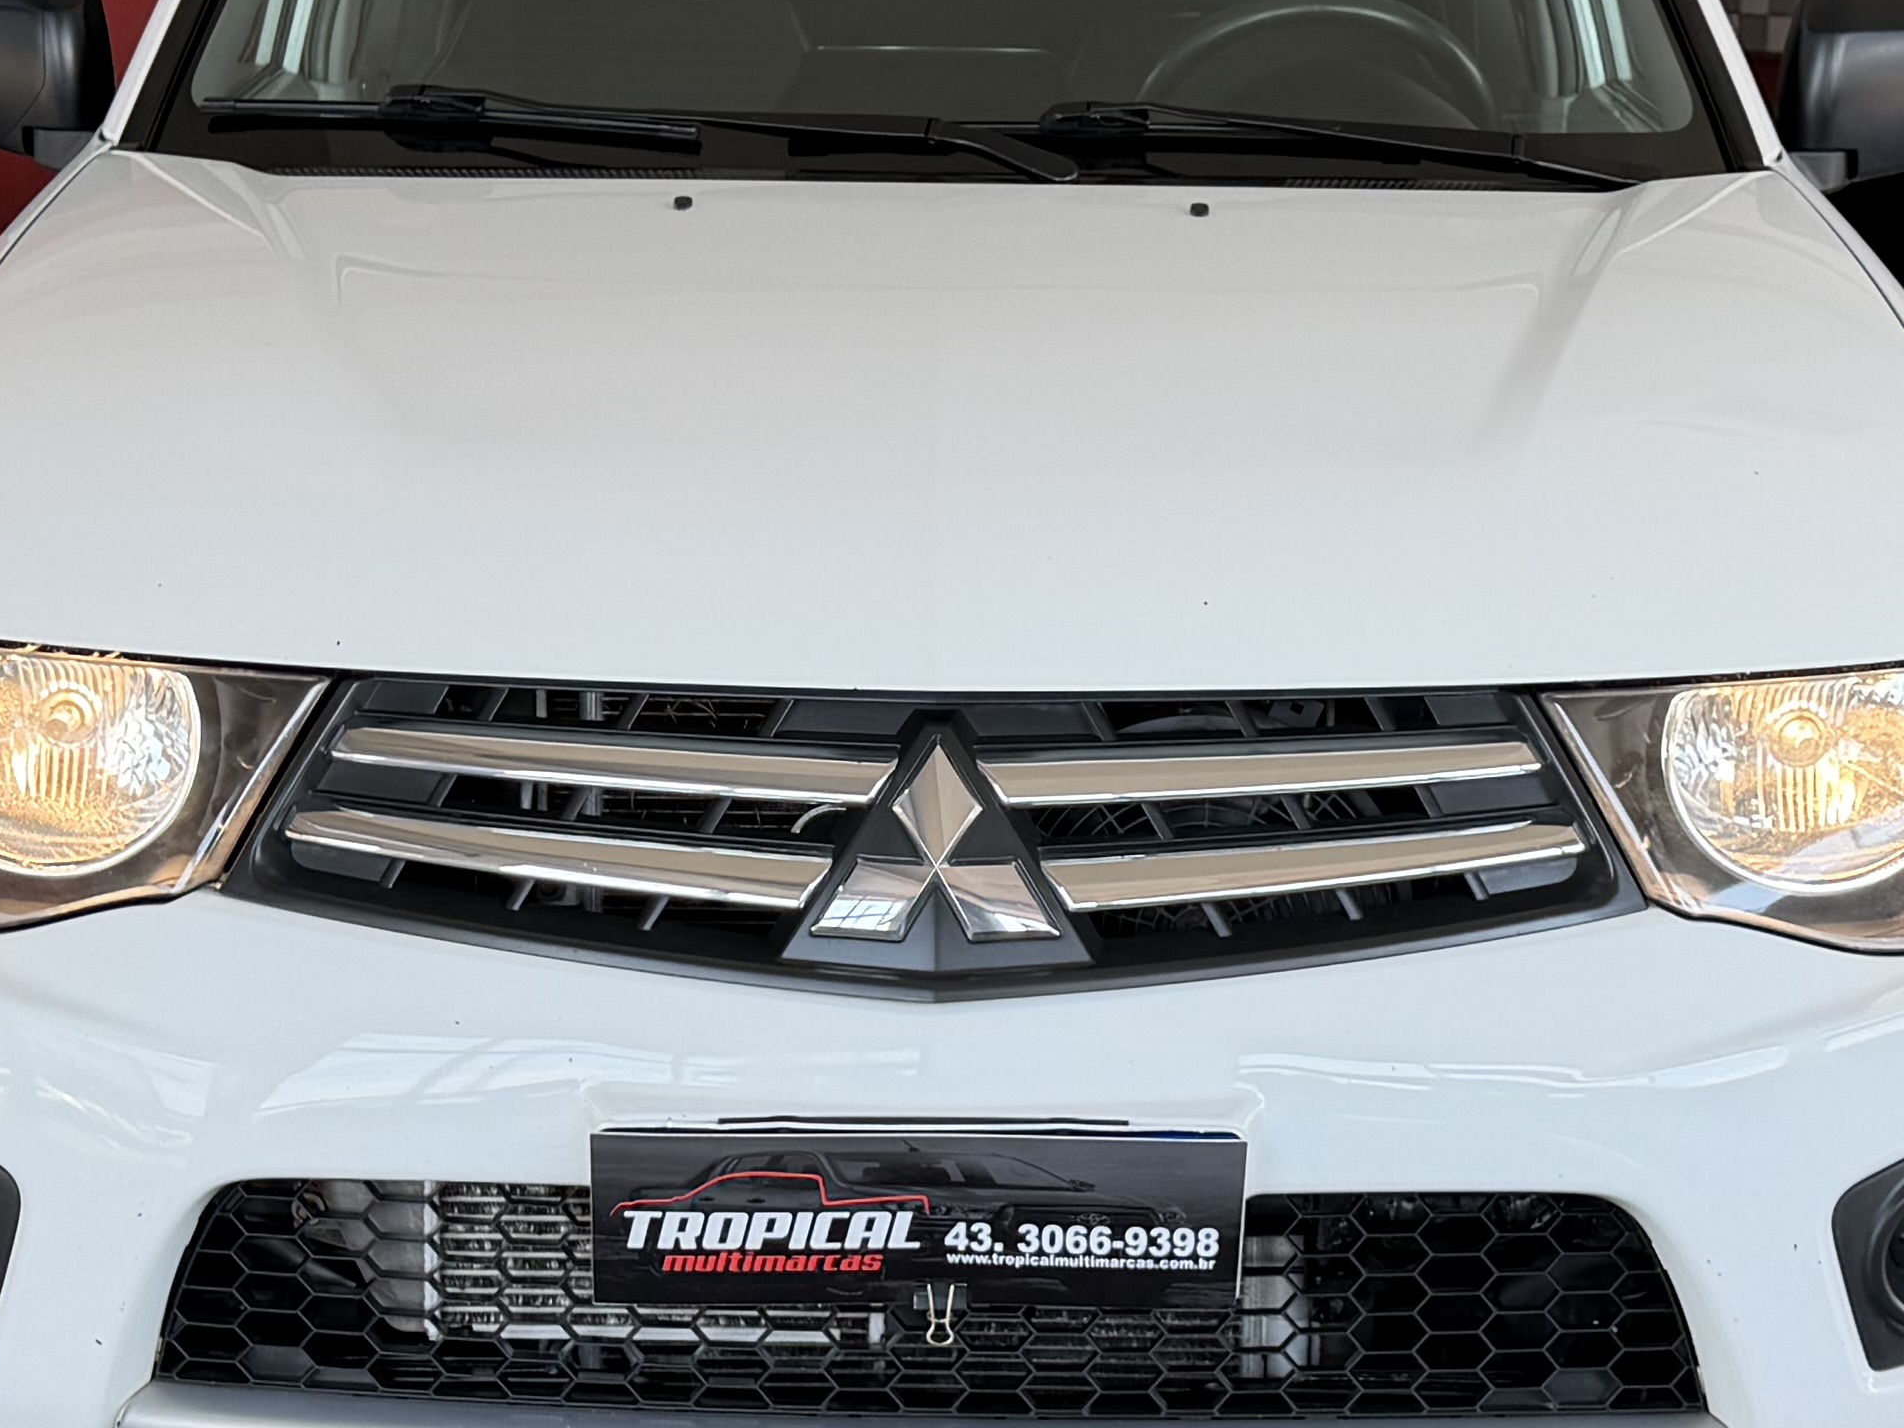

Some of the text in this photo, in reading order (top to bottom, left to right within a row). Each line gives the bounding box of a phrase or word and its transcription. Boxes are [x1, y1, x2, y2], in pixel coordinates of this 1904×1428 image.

[623, 1210, 922, 1251] TROPICAL
[944, 1221, 1220, 1257] 43. 3066-9398
[661, 1251, 885, 1273] multimarcas
[945, 1252, 1217, 1271] www.tropicalmultimarcas.com.br
